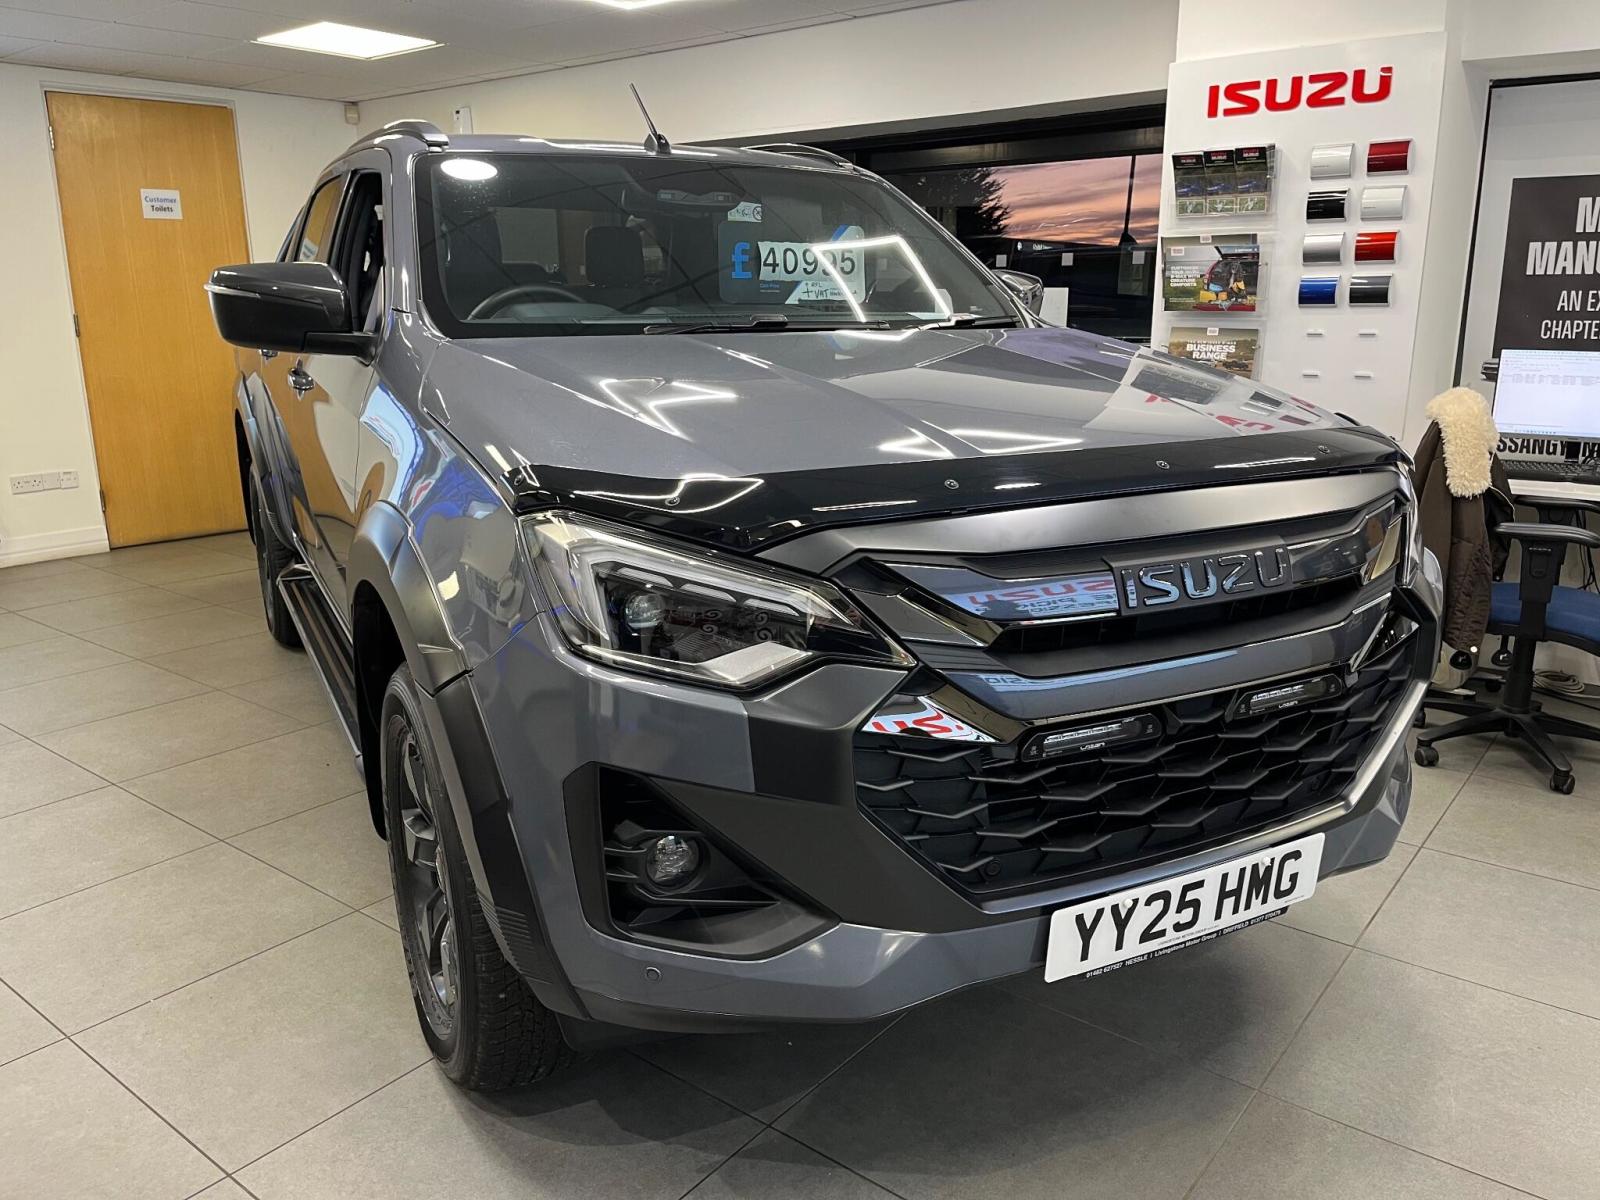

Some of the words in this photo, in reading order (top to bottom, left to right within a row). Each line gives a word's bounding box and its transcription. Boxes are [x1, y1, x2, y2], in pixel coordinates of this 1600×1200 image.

[1207, 66, 1393, 118] ISUZU
[144, 196, 177, 204] Customer
[151, 205, 174, 213] Toilets
[1556, 290, 1583, 312] AN
[1186, 343, 1236, 353] BUSINESS
[1192, 351, 1228, 360] RANGE
[1121, 548, 1287, 608] ISUZU
[1075, 878, 1205, 962] YY25
[1213, 849, 1302, 922] HMG
[1125, 954, 1149, 966] HESSLE
[1154, 942, 1186, 957] Livingstone
[1185, 937, 1201, 947] Motor
[1200, 932, 1218, 942] Group
